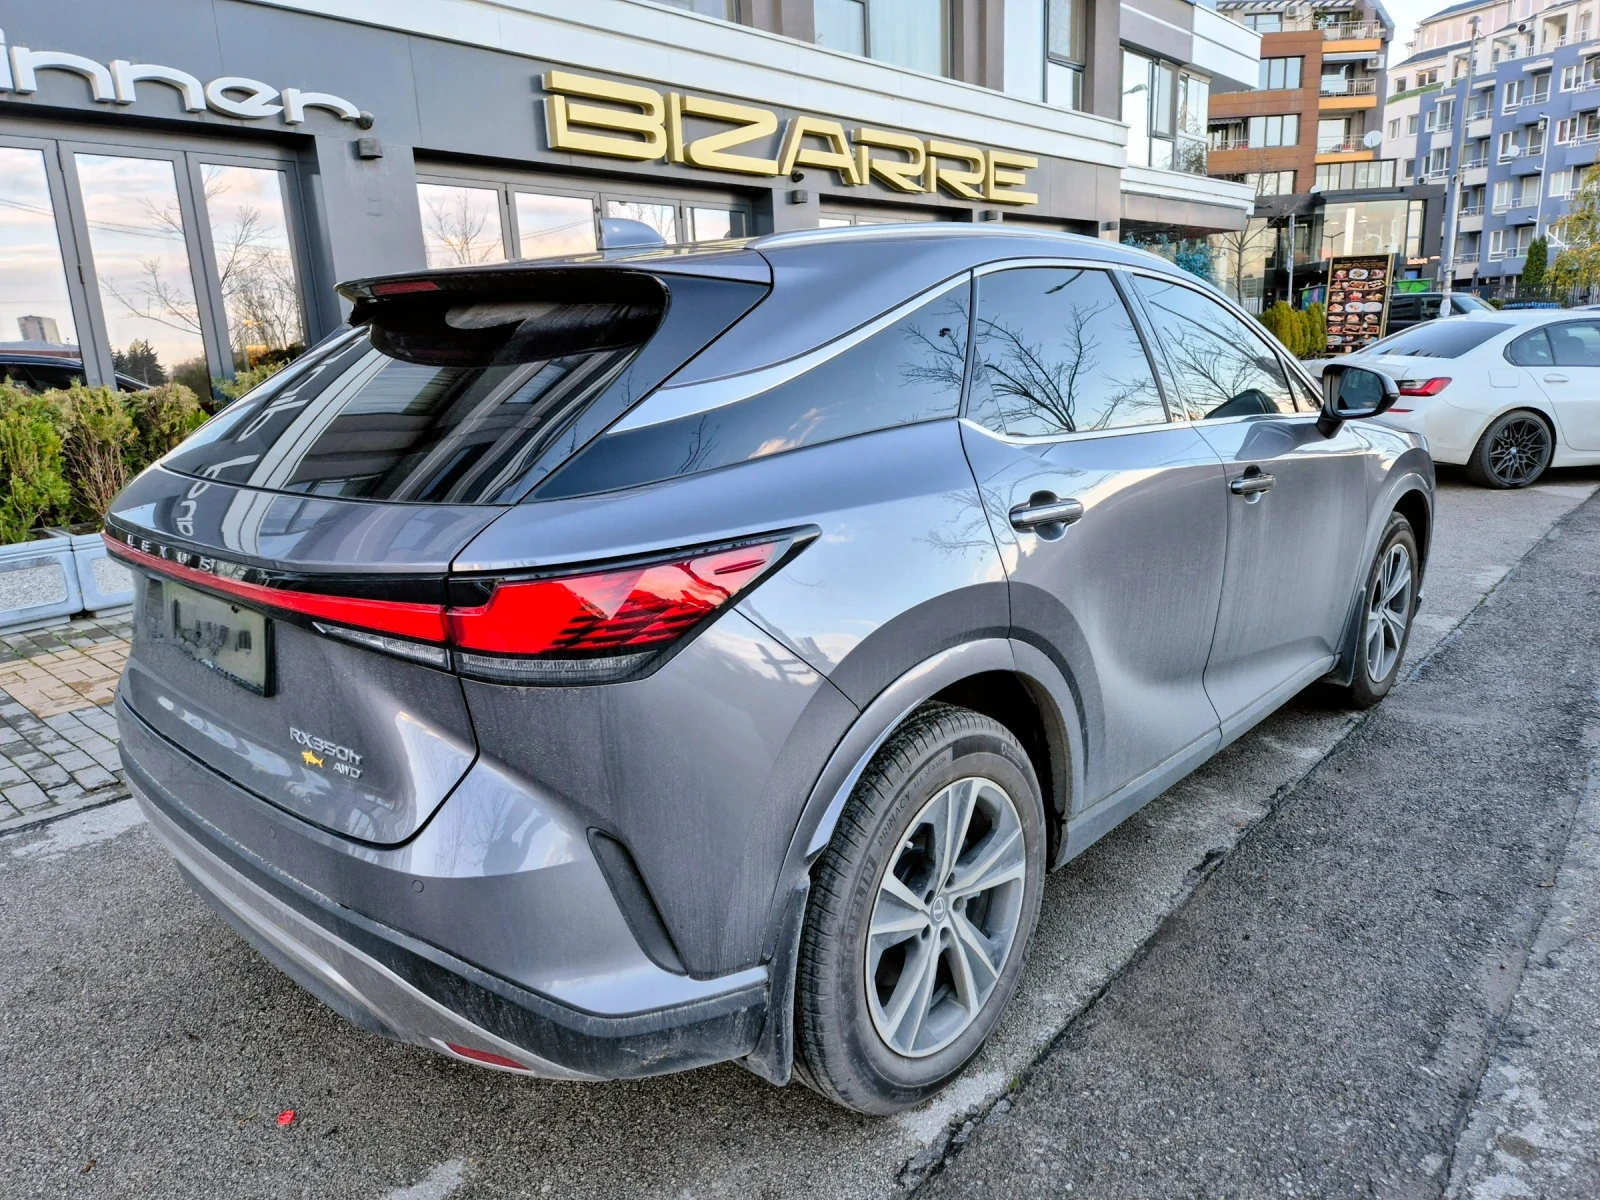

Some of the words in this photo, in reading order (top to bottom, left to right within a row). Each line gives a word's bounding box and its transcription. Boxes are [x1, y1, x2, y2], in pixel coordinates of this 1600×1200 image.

[541, 70, 1039, 205] BIZARRE
[127, 534, 215, 573] LEXUS
[289, 726, 362, 765] RX350h
[332, 761, 362, 778] AWD
[877, 789, 911, 847] PRIMACY
[913, 777, 924, 790] ALL
[924, 754, 948, 776] SEASON
